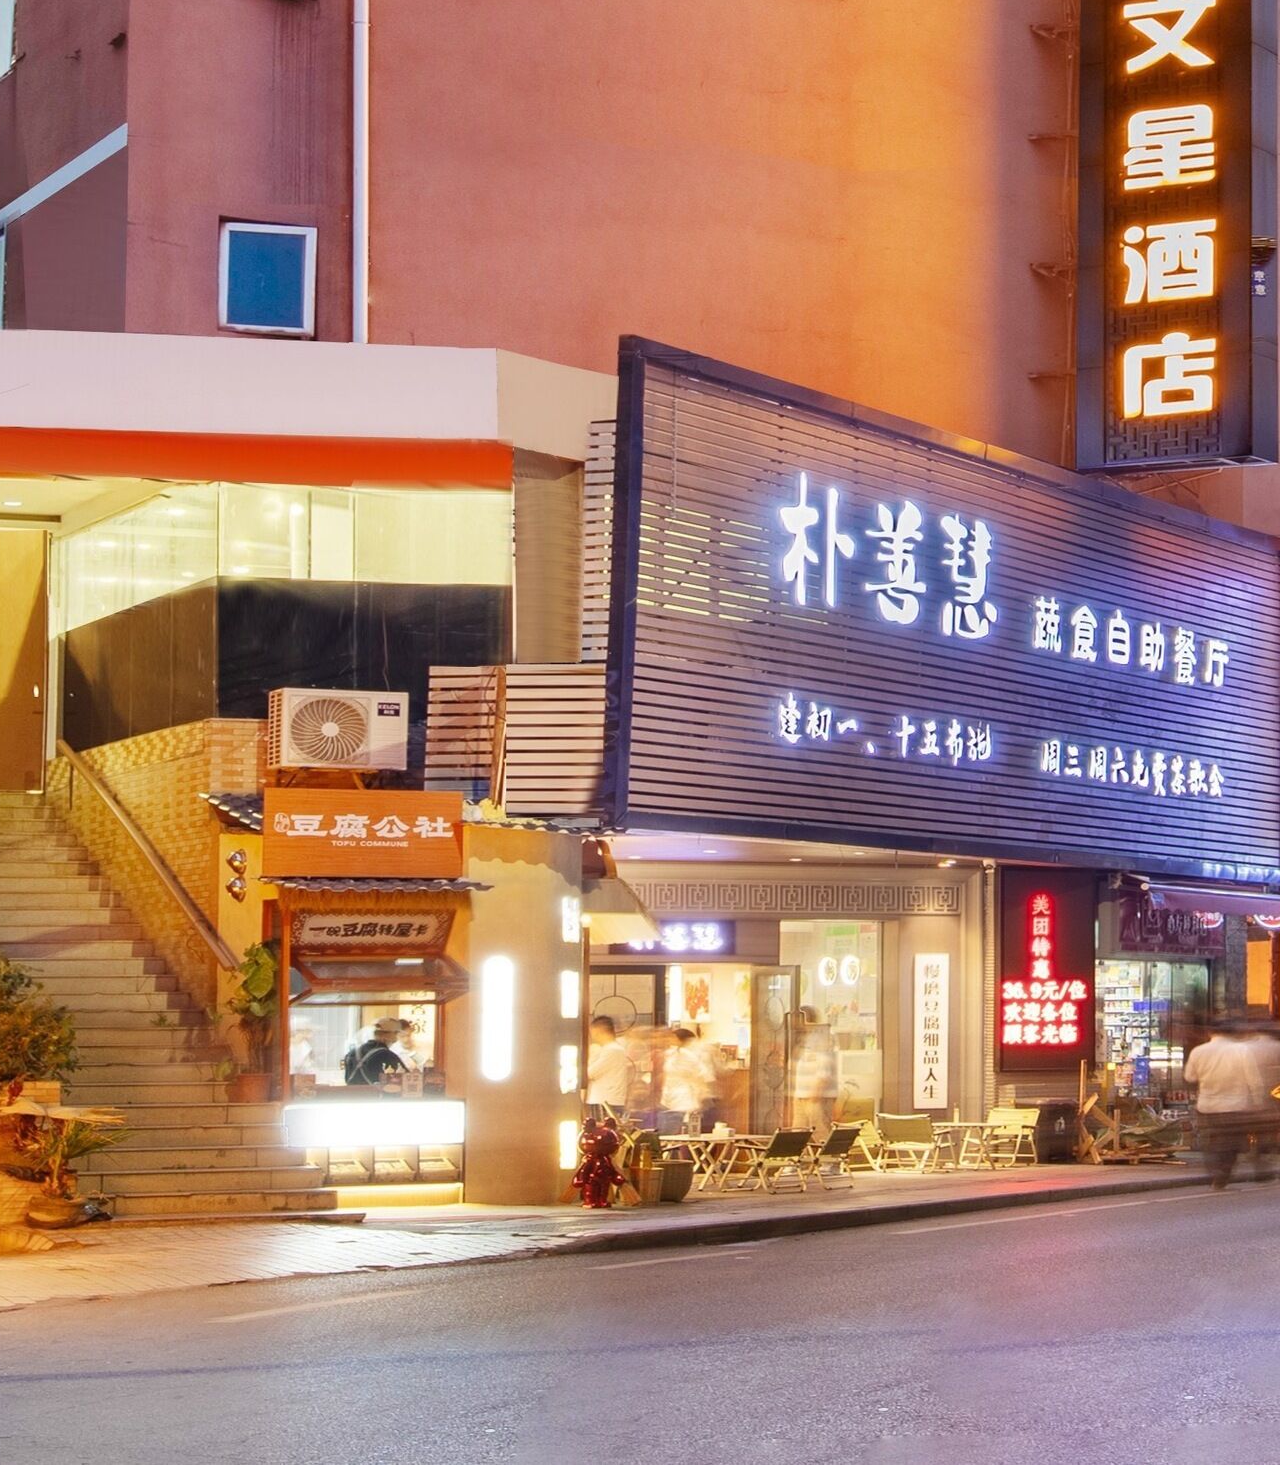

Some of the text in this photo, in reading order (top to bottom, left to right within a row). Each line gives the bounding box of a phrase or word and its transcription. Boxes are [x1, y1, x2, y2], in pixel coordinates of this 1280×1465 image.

[780, 472, 1230, 687] 朴善慧 蔬食自助餐厅
[286, 814, 455, 839] 豆腐公社
[359, 840, 409, 848] COMMUNE
[1031, 894, 1051, 979] 美团特惠
[1003, 1002, 1079, 1023] 欢迎各位
[1002, 1023, 1079, 1044] 顾客光临
